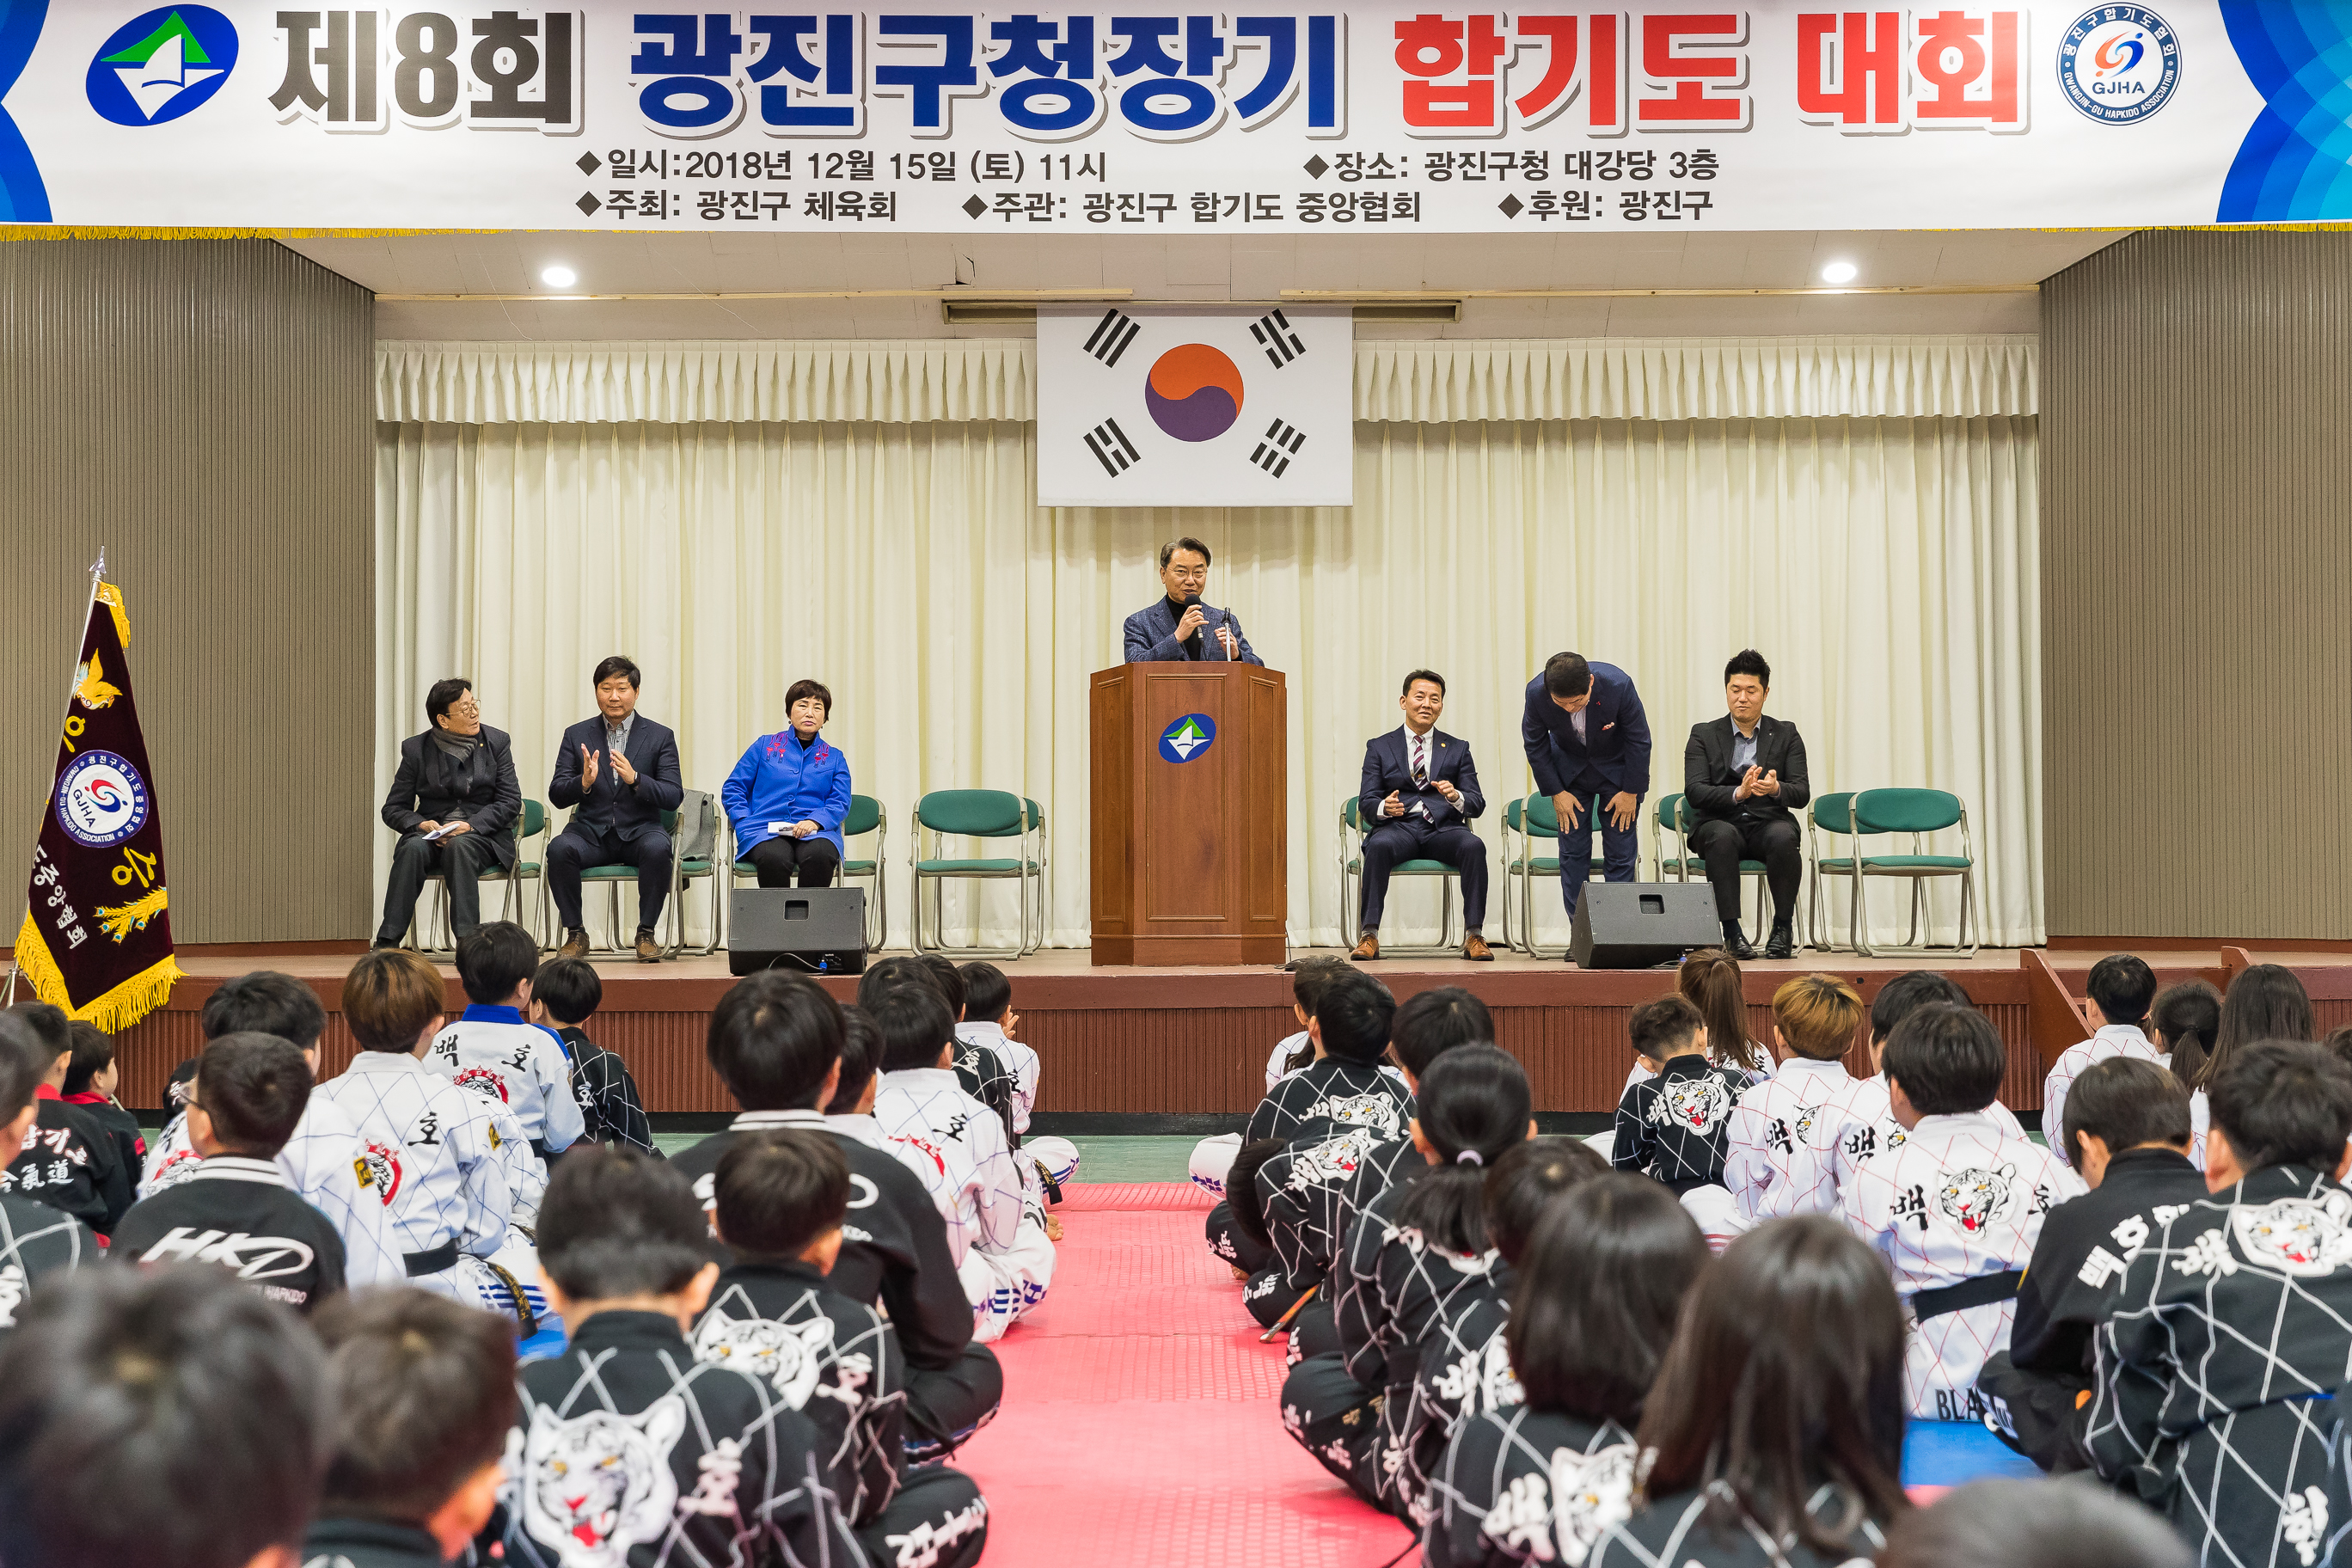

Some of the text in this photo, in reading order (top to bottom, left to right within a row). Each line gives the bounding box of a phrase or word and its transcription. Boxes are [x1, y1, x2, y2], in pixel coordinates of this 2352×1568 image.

[2062, 7, 2176, 57] 광진구합기도협회
[267, 10, 2018, 130] 제8회 광진구청장기 합기도 대회
[2092, 81, 2146, 95] GJHA
[2063, 69, 2176, 119] GWANGJIN-GU HAPKIDO ASSOCIATION
[809, 150, 874, 181] 12월
[891, 151, 956, 181] 15일
[971, 150, 1025, 184] (토)
[1041, 151, 1106, 182] 11시
[1334, 149, 1719, 182] 장소: 광진구청 대강당 3층
[606, 189, 896, 222] 주최: 광진구 체육회
[992, 191, 1420, 224] 주관: 광진구 합기도 중앙협회
[1528, 190, 1713, 222] 후원: 광진구
[60, 806, 77, 832] HAPKIDO
[74, 830, 116, 843] ASSOCIATION
[73, 788, 96, 829] GJHA
[433, 1033, 460, 1068] 백
[407, 1111, 440, 1147] 호
[1765, 1118, 1794, 1155] 백
[1890, 1183, 1929, 1232] 백
